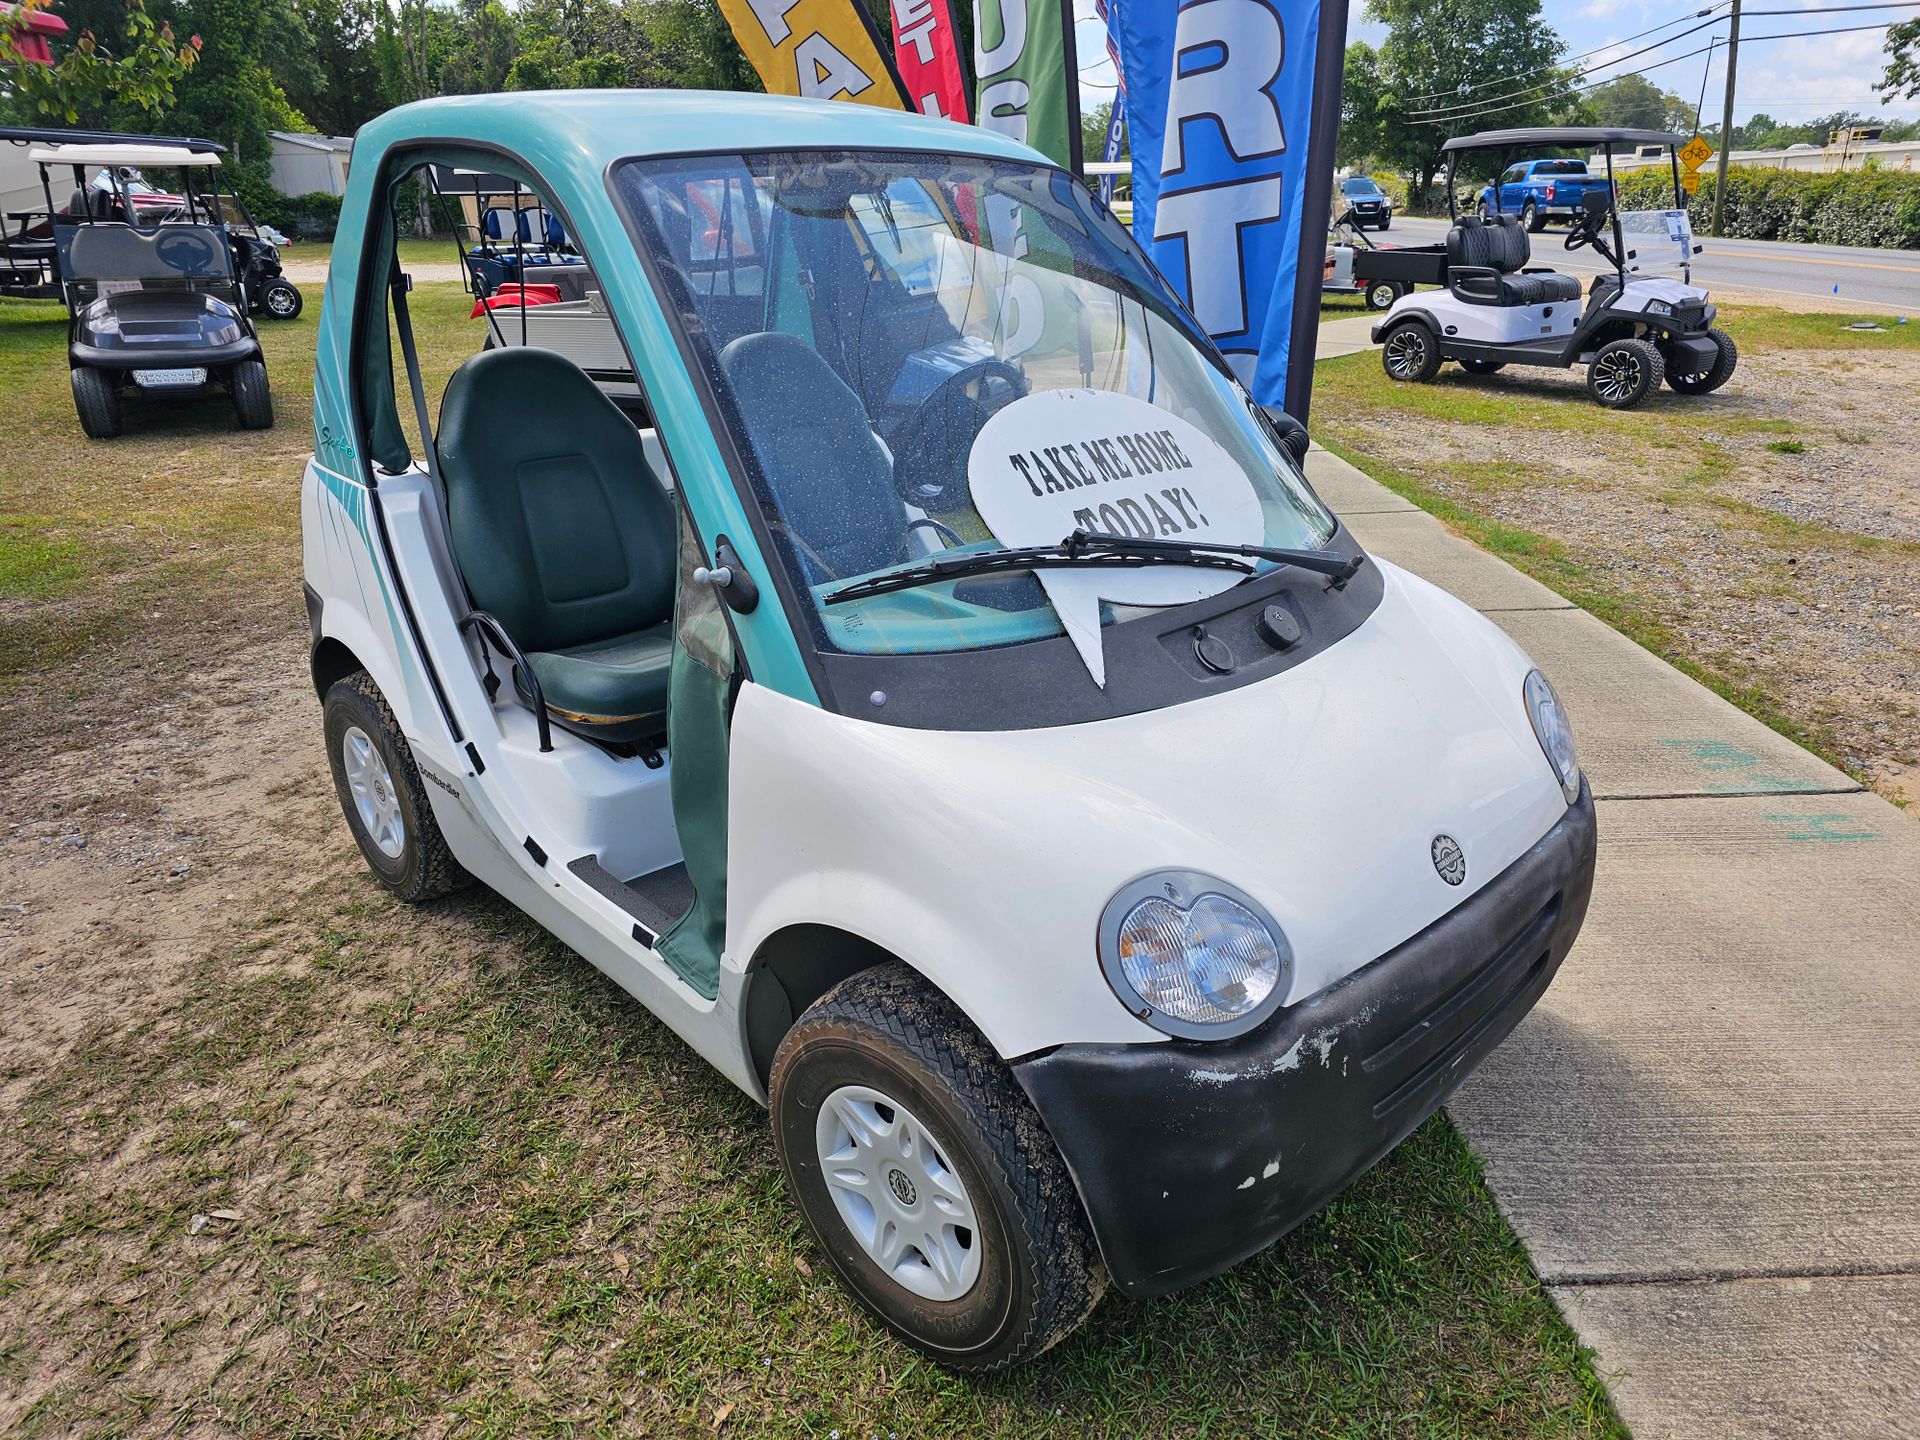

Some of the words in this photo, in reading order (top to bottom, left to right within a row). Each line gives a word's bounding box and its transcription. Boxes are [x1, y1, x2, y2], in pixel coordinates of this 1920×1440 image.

[1009, 444, 1097, 496] TAKE
[1080, 436, 1133, 482] ME
[1116, 430, 1193, 476] HOME
[1073, 487, 1210, 539] TODAY!
